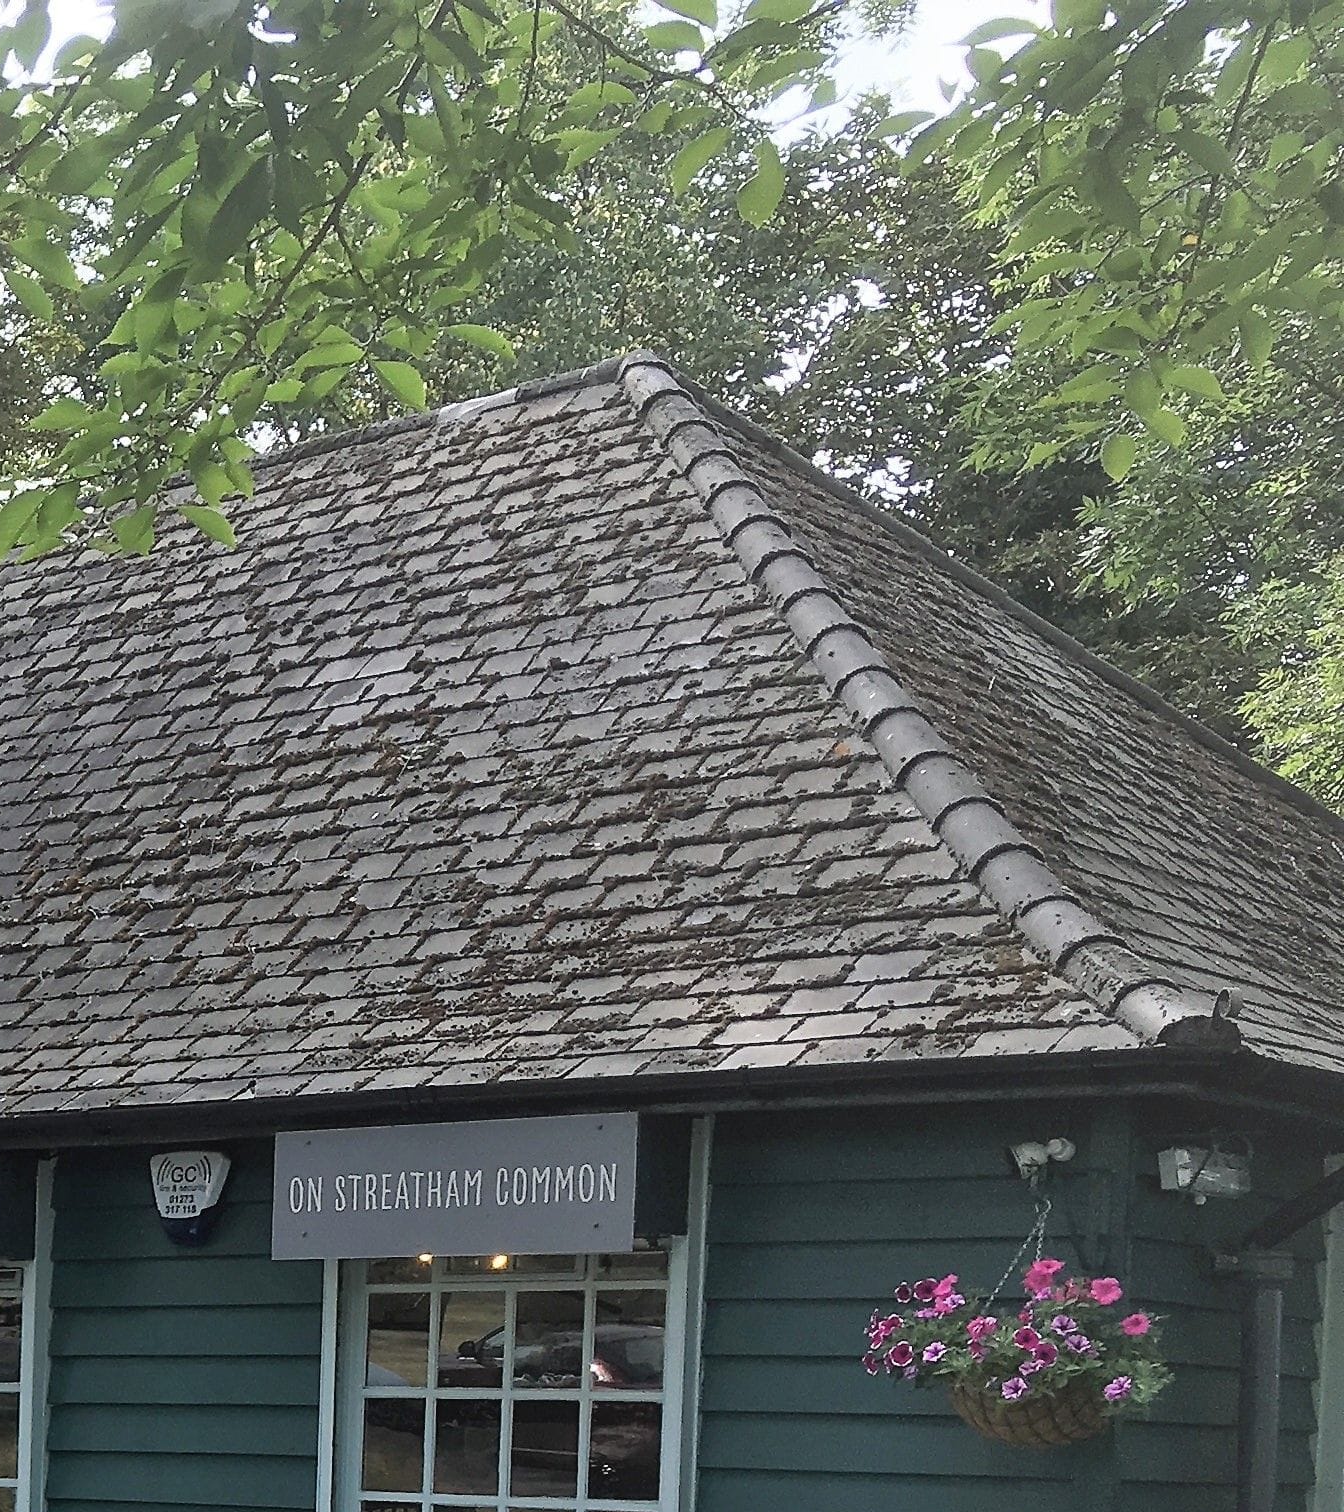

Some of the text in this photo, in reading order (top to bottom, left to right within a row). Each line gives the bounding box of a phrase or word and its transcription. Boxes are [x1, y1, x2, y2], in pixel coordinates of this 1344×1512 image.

[172, 1165, 197, 1183] GC
[289, 1163, 617, 1214] ON STREATHAM COMMON
